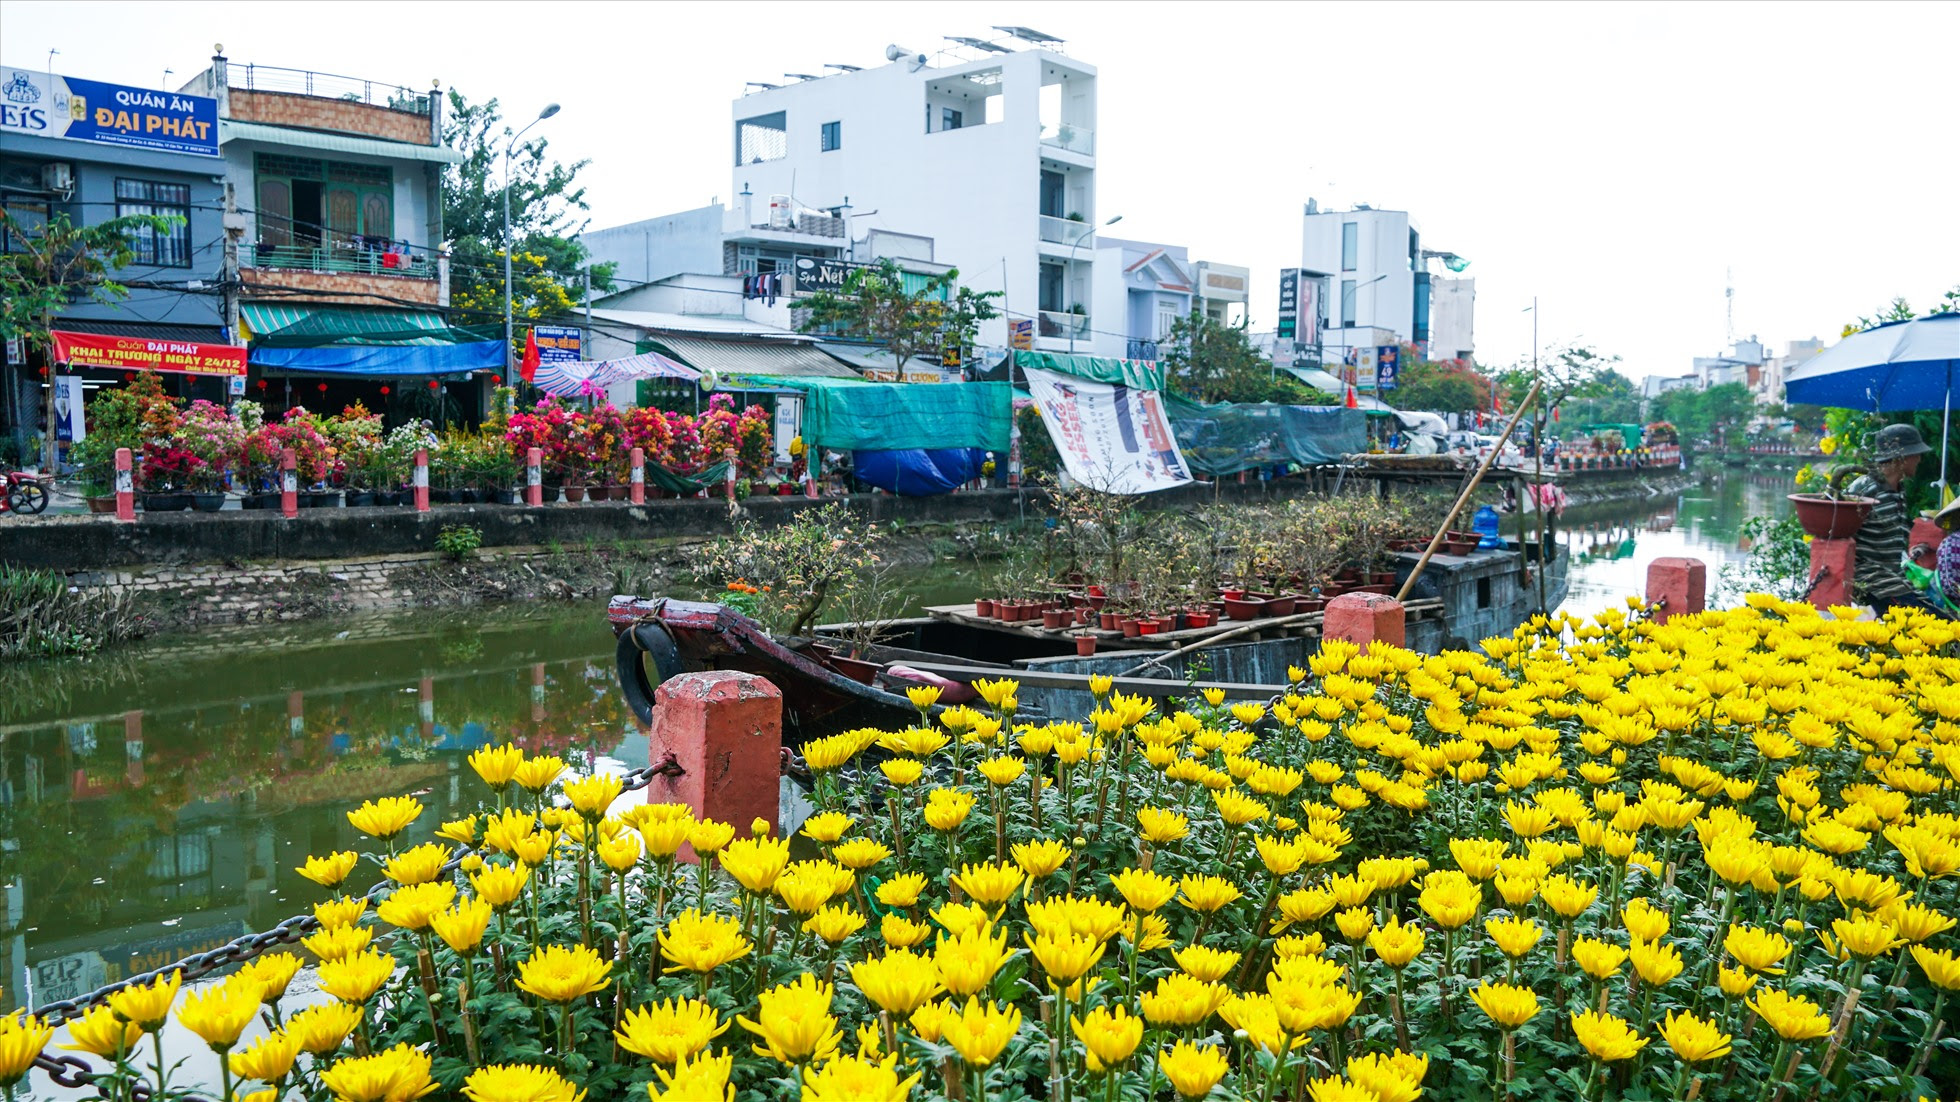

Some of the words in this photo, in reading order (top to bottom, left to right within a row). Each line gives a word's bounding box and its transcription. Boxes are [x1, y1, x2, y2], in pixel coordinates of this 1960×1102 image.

[115, 90, 166, 109] QUÁN
[169, 95, 194, 113] ĂN
[94, 107, 140, 134] ĐẠI
[146, 114, 211, 140] PHÁT
[799, 271, 816, 283] Spa
[818, 265, 844, 285] Nét
[69, 346, 103, 357] KHAI
[106, 349, 162, 362] TRƯƠNG
[165, 352, 201, 366] NGÀY
[204, 357, 241, 369] 24/12
[116, 339, 146, 350] Quán
[147, 341, 168, 355] ĐẠI
[169, 342, 199, 355] PHÁT
